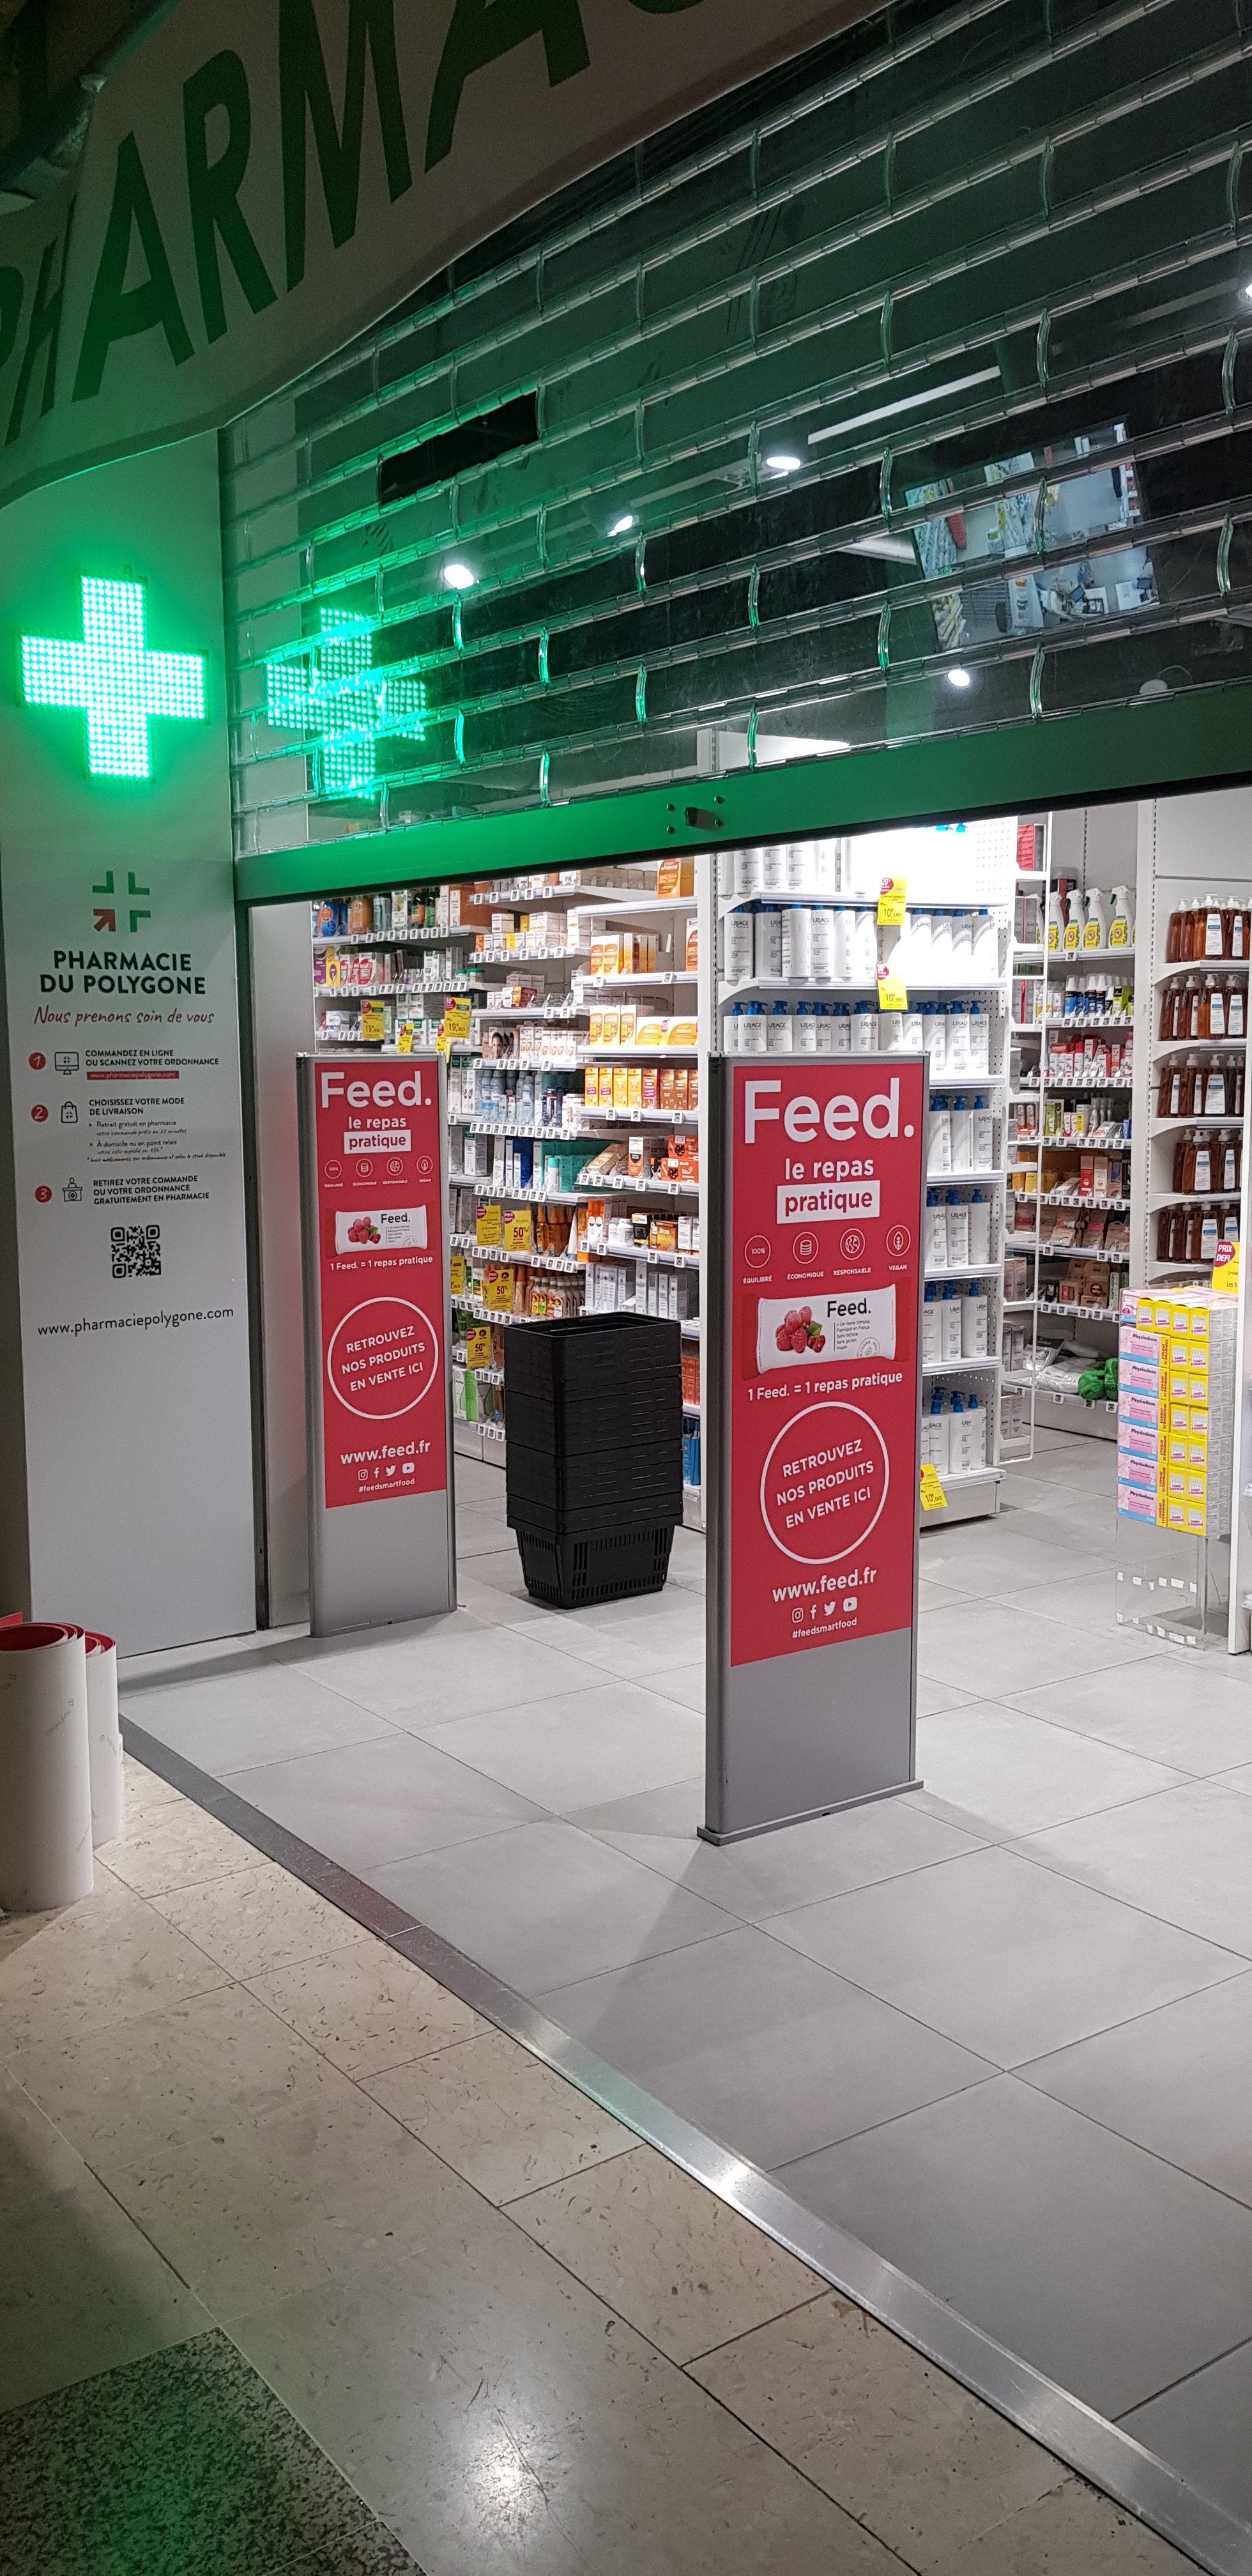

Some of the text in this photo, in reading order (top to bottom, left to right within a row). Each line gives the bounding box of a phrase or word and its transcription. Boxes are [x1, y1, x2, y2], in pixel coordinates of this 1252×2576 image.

[54, 950, 192, 971] PHARMACIE
[40, 974, 206, 995] DU POLYGONE
[34, 1005, 215, 1026] Nous prenons soin de vous
[321, 1070, 432, 1108] Feed.
[34, 1107, 45, 1120] 2
[102, 1107, 144, 1116] LIVRAISON
[745, 1077, 915, 1144] Feed.
[348, 1116, 407, 1130] le repas
[349, 1134, 406, 1150] pratique
[784, 1158, 874, 1182] le repas
[93, 1179, 124, 1187] RETIREZ
[152, 1175, 198, 1184] COMMANDE
[134, 1184, 190, 1193] ORDONNANCE
[40, 1188, 47, 1200] 3
[94, 1195, 151, 1205] GRATUITEMENT
[165, 1192, 210, 1201] PHARMACIE
[784, 1189, 873, 1217] pratique
[381, 1212, 411, 1224] Feed.
[751, 1246, 766, 1255] 100%
[1218, 1244, 1233, 1253] PRIX
[336, 1261, 358, 1271] Feed.
[368, 1260, 372, 1268] 1
[374, 1258, 398, 1268] repas
[399, 1255, 434, 1266] pratique
[833, 1267, 871, 1276] RESPONSABLE
[743, 1275, 772, 1284] ÉQUILIBRÉ
[787, 1270, 824, 1280] ÉCONOMIQUE
[827, 1298, 871, 1318] Feed.
[37, 1308, 234, 1337] www.pharmaciepolygone.com
[346, 1326, 415, 1353] RETROUVEZ
[341, 1342, 426, 1375] NOS PRODUITS
[349, 1361, 424, 1392] EN VENTE ICI
[748, 1388, 754, 1401] 1
[757, 1384, 790, 1400] Feed.
[805, 1382, 811, 1394] 1
[814, 1379, 848, 1393] repas
[851, 1371, 903, 1389] pratique
[340, 1439, 431, 1464] www.feed.fr
[782, 1439, 863, 1477] RETROUVEZ
[358, 1478, 415, 1493] #feedsmartfood
[776, 1460, 874, 1506] NOS PRODUITS
[786, 1487, 871, 1529] EN VENTE ICI
[772, 1567, 877, 1602] www.feed.fr
[792, 1617, 857, 1639] #feedsmartfood
